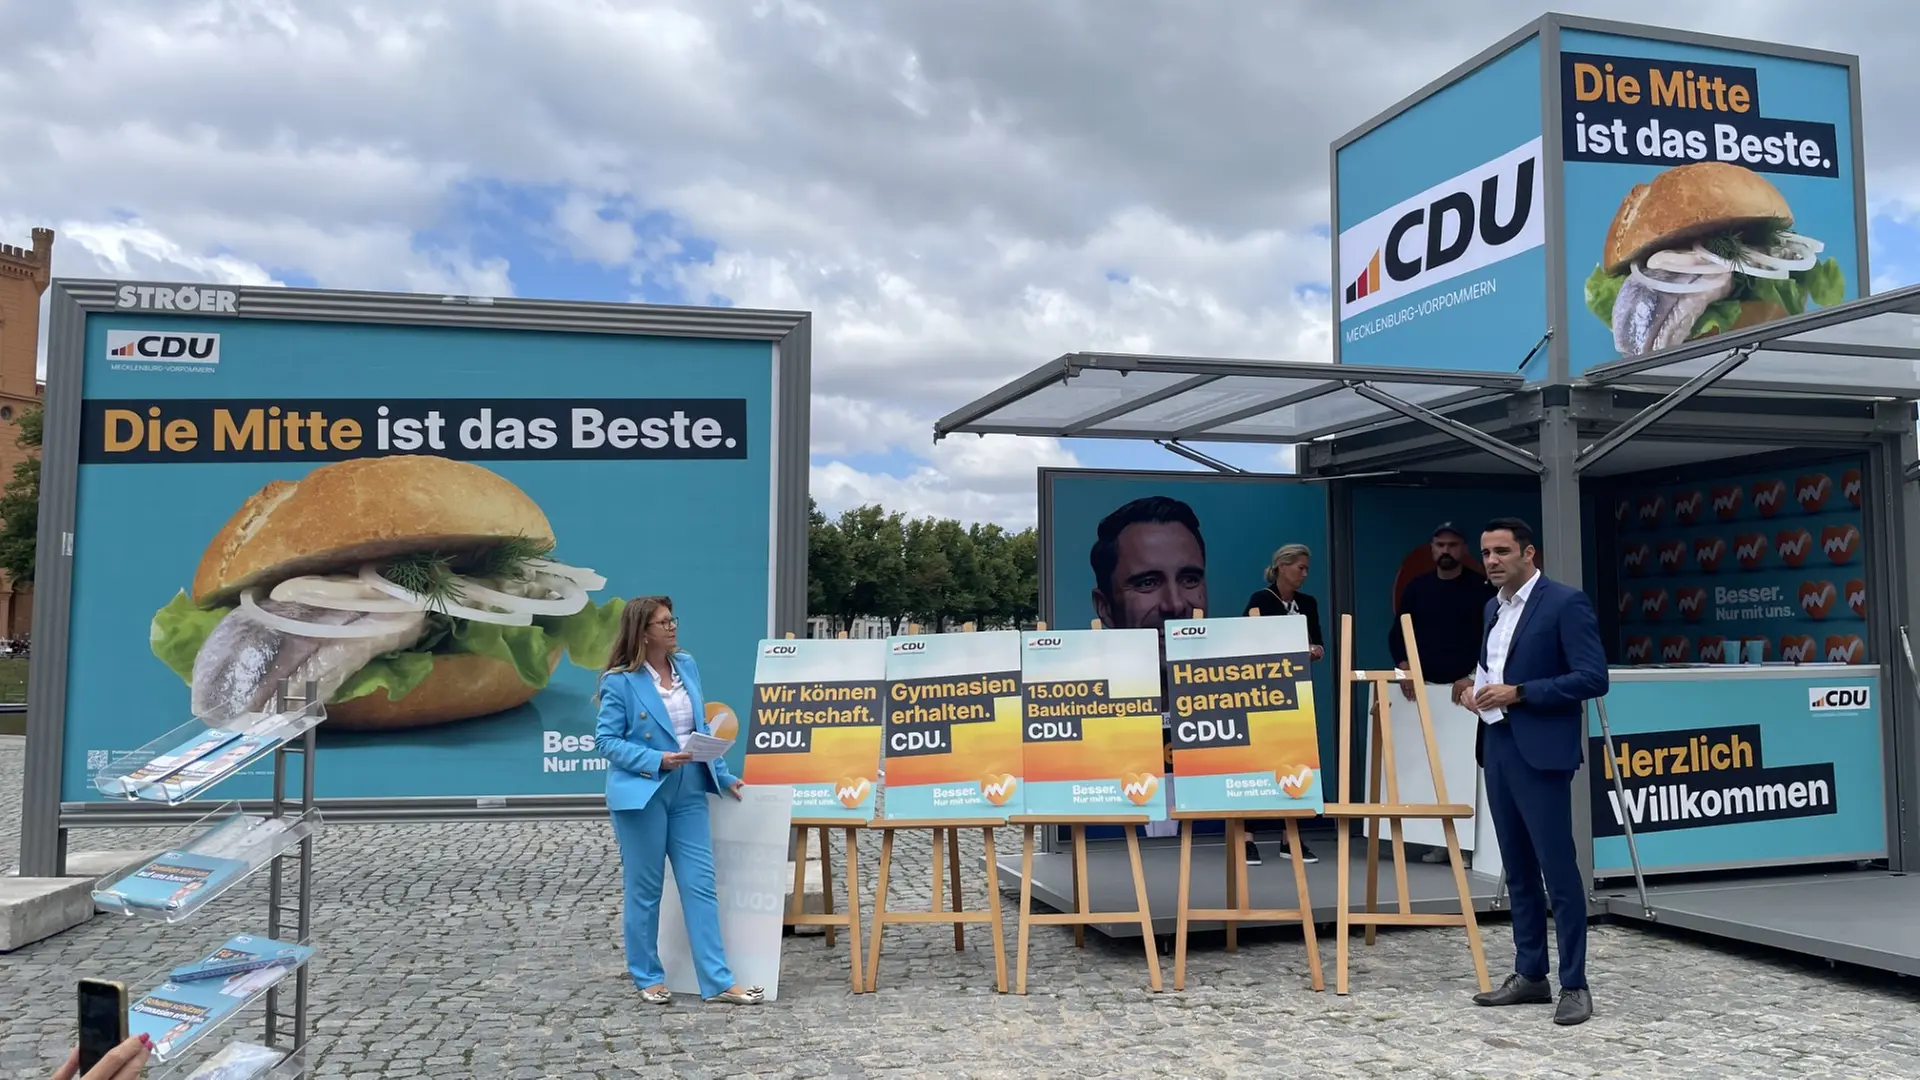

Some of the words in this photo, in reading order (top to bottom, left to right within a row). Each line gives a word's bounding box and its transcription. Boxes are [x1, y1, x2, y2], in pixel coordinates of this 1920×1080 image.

[1574, 62, 1641, 105] Die
[1649, 67, 1751, 113] Mitte
[1575, 111, 1629, 156] ist
[1636, 118, 1708, 161] das
[1713, 123, 1831, 169] Beste.
[1384, 156, 1536, 282] CDU
[117, 284, 237, 313] STRÖER
[1345, 278, 1497, 343] MECKLENBURG-VORPOMMERN
[136, 335, 216, 359] CDU
[110, 363, 216, 374] MECKLENBURG-VORPOMMERN
[103, 406, 199, 453] Die
[213, 406, 363, 452] Mitte
[376, 405, 446, 450] ist
[458, 408, 558, 450] das
[571, 408, 737, 449] Beste.
[1714, 585, 1785, 605] Besser.
[1716, 607, 1740, 621] Nur
[1741, 605, 1763, 619] mit
[1765, 604, 1796, 618] uns.
[1180, 626, 1206, 636] CDU
[772, 646, 797, 655] CDU
[900, 642, 926, 651] CDU
[1036, 638, 1062, 647] CDU
[1172, 658, 1304, 685] Hausarzt-
[759, 684, 797, 704] Wir
[800, 683, 877, 702] können
[891, 675, 1017, 704] Gymnasien
[1027, 682, 1089, 699] 15.000
[1092, 681, 1105, 697] €
[1824, 689, 1868, 707] CDU
[1027, 698, 1158, 718] Baukindergeld.
[1175, 684, 1293, 718] garantie.
[757, 705, 875, 726] Wirtschaft.
[891, 702, 991, 725] erhalten.
[754, 730, 806, 749] CDU.
[890, 729, 946, 752] CDU.
[1027, 721, 1078, 740] CDU.
[1177, 718, 1244, 743] CDU.
[543, 730, 596, 753] Bes
[543, 756, 580, 773] Nur
[582, 757, 608, 771] mi
[1603, 734, 1754, 780] Herzlich
[933, 787, 976, 798] Besser.
[1072, 784, 1117, 796] Besser.
[1225, 777, 1271, 789] Besser.
[1226, 789, 1243, 798] Nur
[1244, 788, 1259, 797] mit
[1607, 778, 1830, 826] Willkommen
